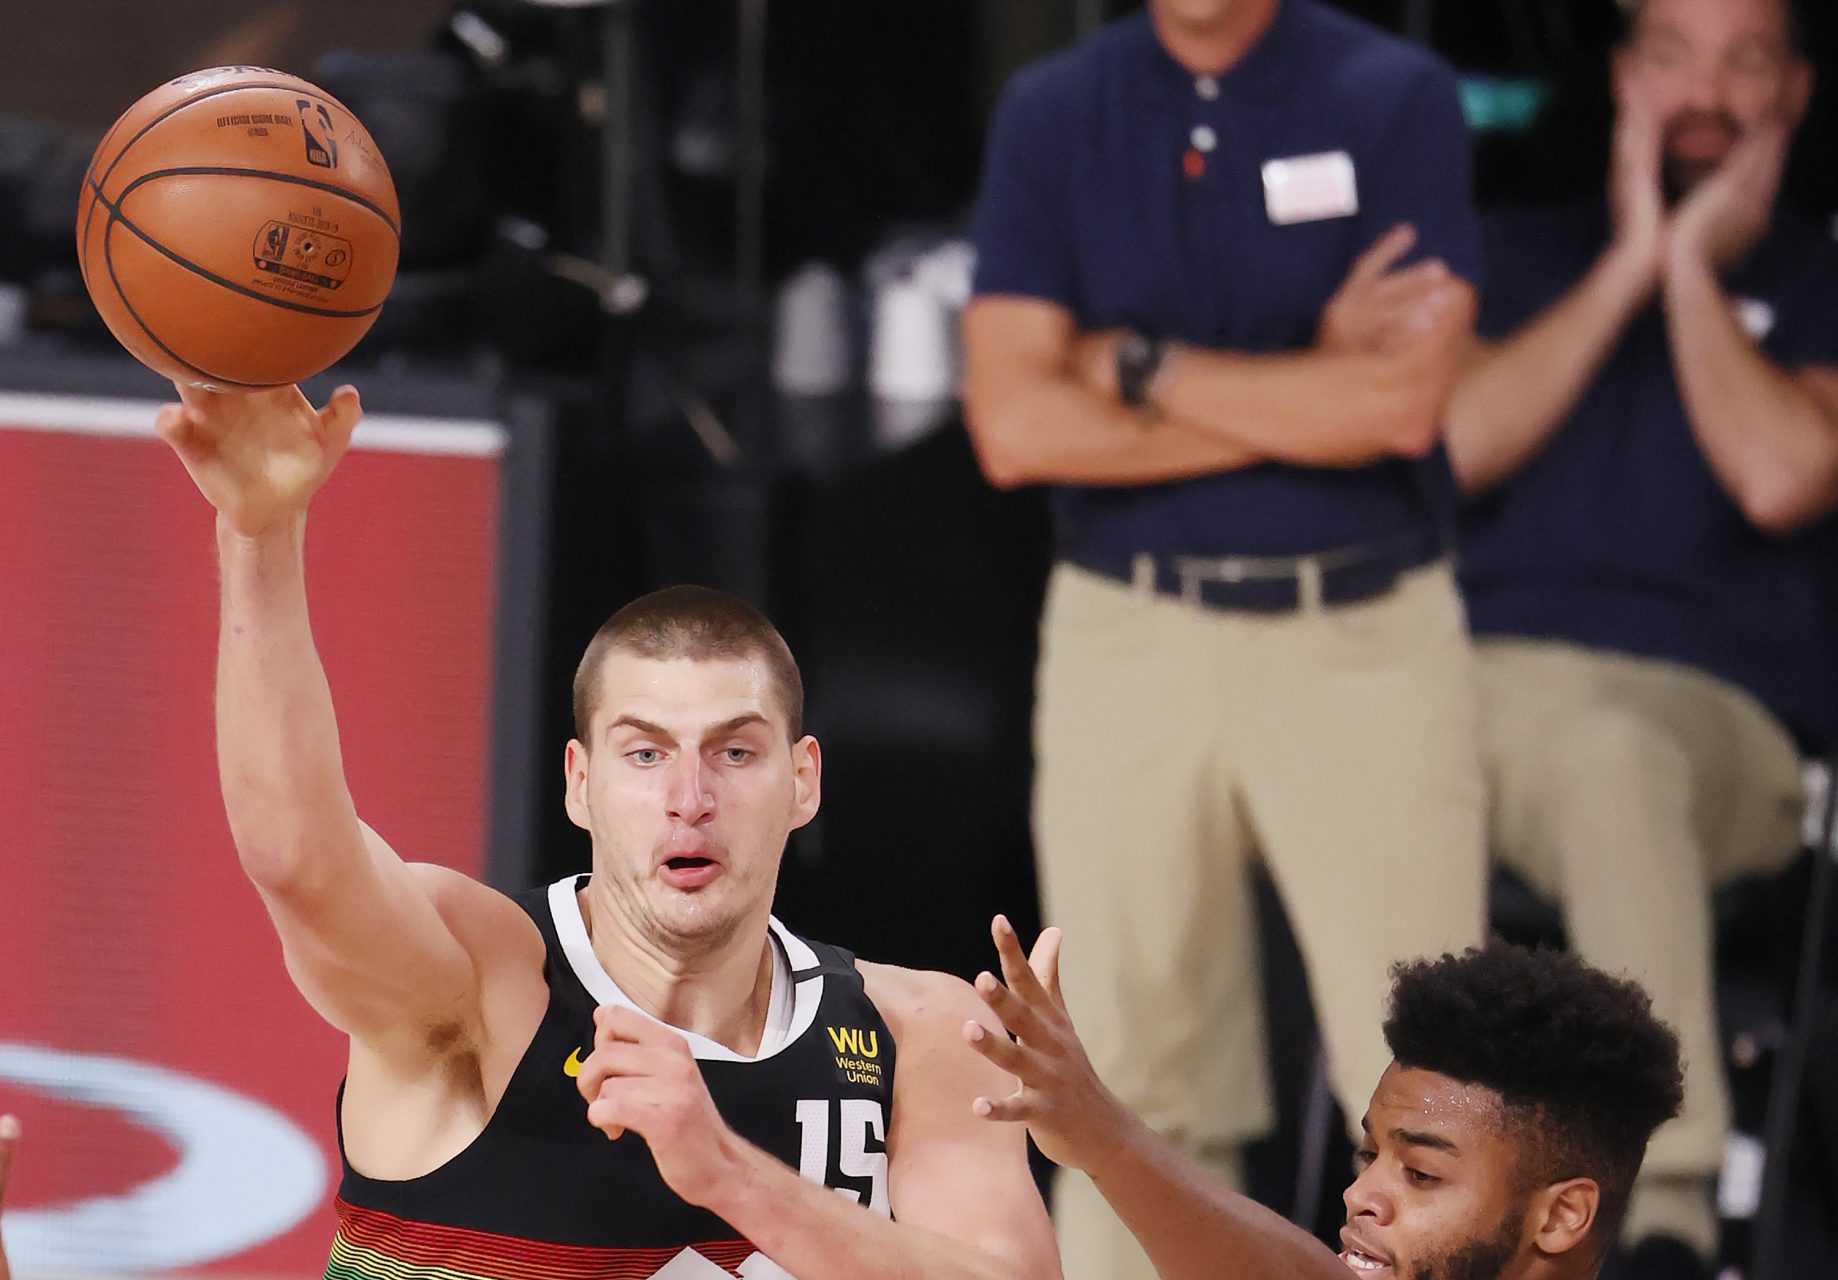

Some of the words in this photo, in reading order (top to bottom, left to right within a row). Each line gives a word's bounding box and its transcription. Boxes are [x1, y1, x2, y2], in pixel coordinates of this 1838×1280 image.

[827, 1026, 879, 1059] WU
[835, 1056, 882, 1076] Western
[847, 1070, 880, 1086] Union
[795, 1099, 891, 1220] 15
